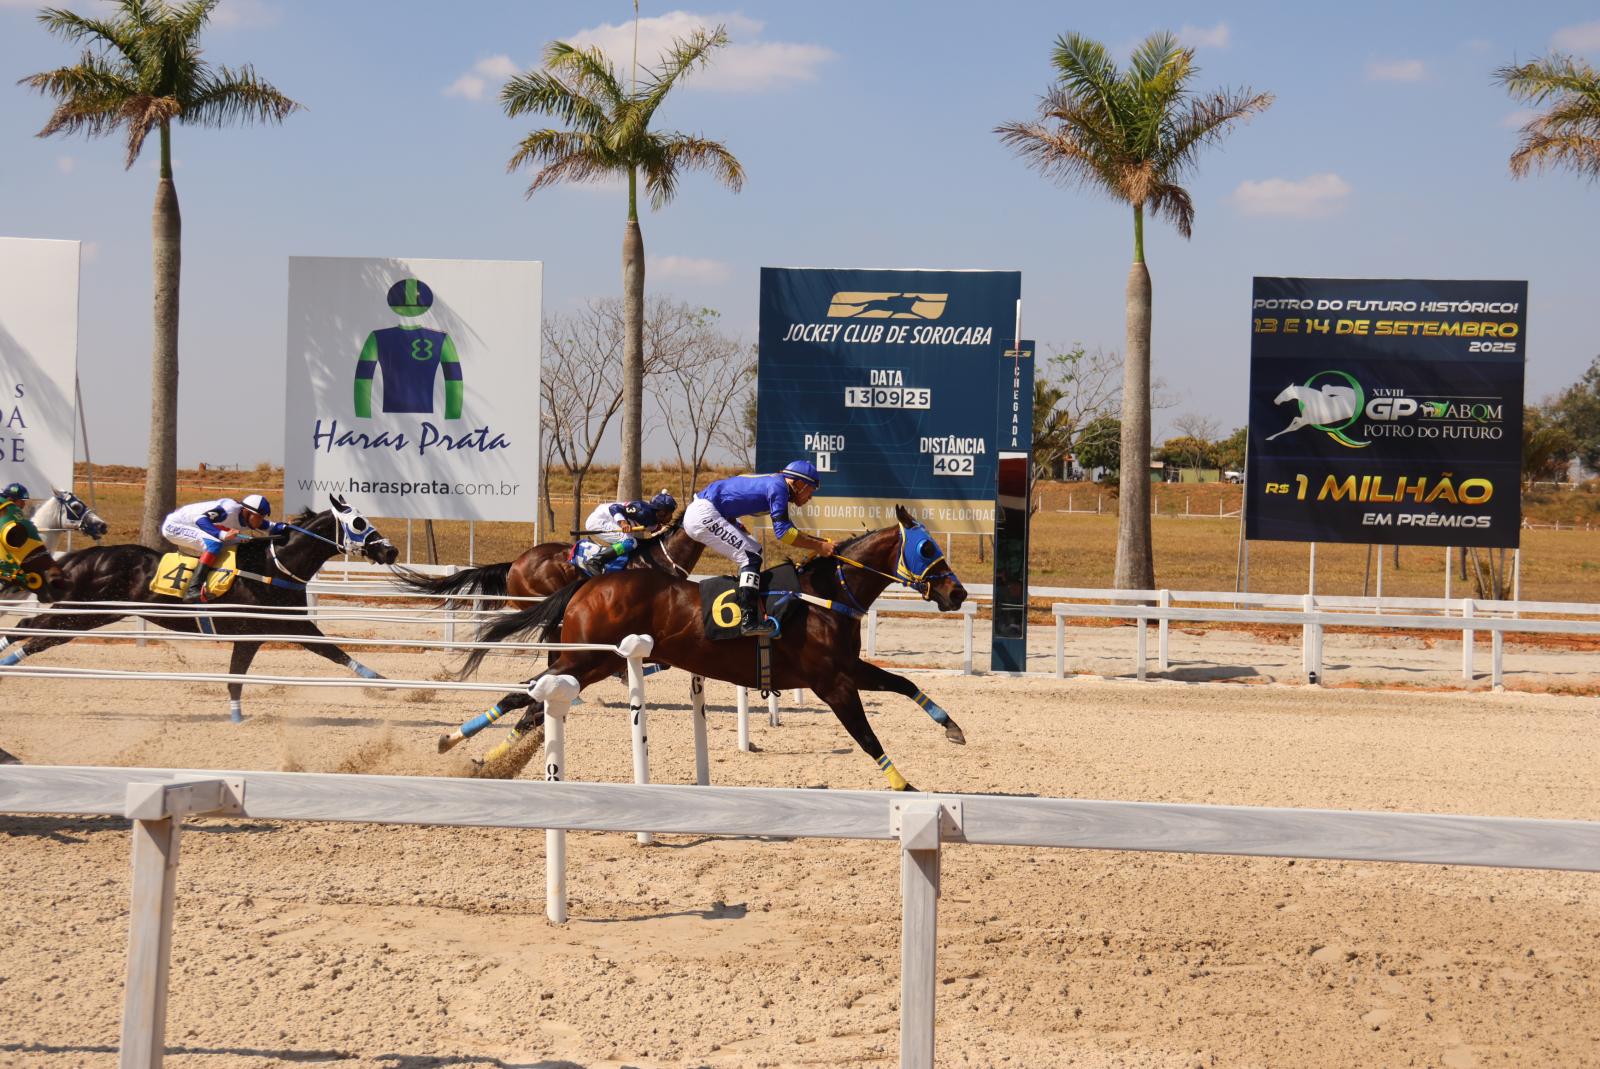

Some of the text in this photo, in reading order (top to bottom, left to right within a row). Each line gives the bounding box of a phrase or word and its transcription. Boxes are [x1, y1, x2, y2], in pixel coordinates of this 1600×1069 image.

[1254, 299, 1314, 310] POTRO
[1317, 300, 1343, 311] DO
[1346, 300, 1417, 312] FUTURO
[783, 323, 993, 345] JOCKEY CLUB DE SOROCABA
[1254, 318, 1519, 338] 13 E 14 DE SETEMBRO
[1468, 341, 1517, 353] 2025
[870, 370, 903, 386] DATA
[1372, 388, 1404, 397] XLVIII
[1011, 366, 1020, 447] CHEGADA
[1365, 398, 1503, 423] GP ABQM
[313, 419, 511, 456] Haras Prata
[1364, 424, 1503, 439] POTRO DO FUTURO
[804, 432, 845, 451] PÁREO
[920, 435, 985, 454] DISTÂNCIA
[820, 454, 827, 468] 1
[934, 458, 973, 473] 402
[297, 477, 520, 497] www.harasprata.com.br
[1265, 472, 1494, 505] R$ 1 MILHÃO
[807, 505, 820, 517] DO
[824, 505, 865, 518] QUARTO
[869, 506, 881, 518] DE
[922, 507, 935, 520] DE
[1362, 512, 1491, 528] EM PRÊMIOS
[702, 518, 745, 550] J.SOUSA
[162, 562, 188, 590] 4
[711, 588, 742, 628] 6
[630, 704, 642, 726] 7
